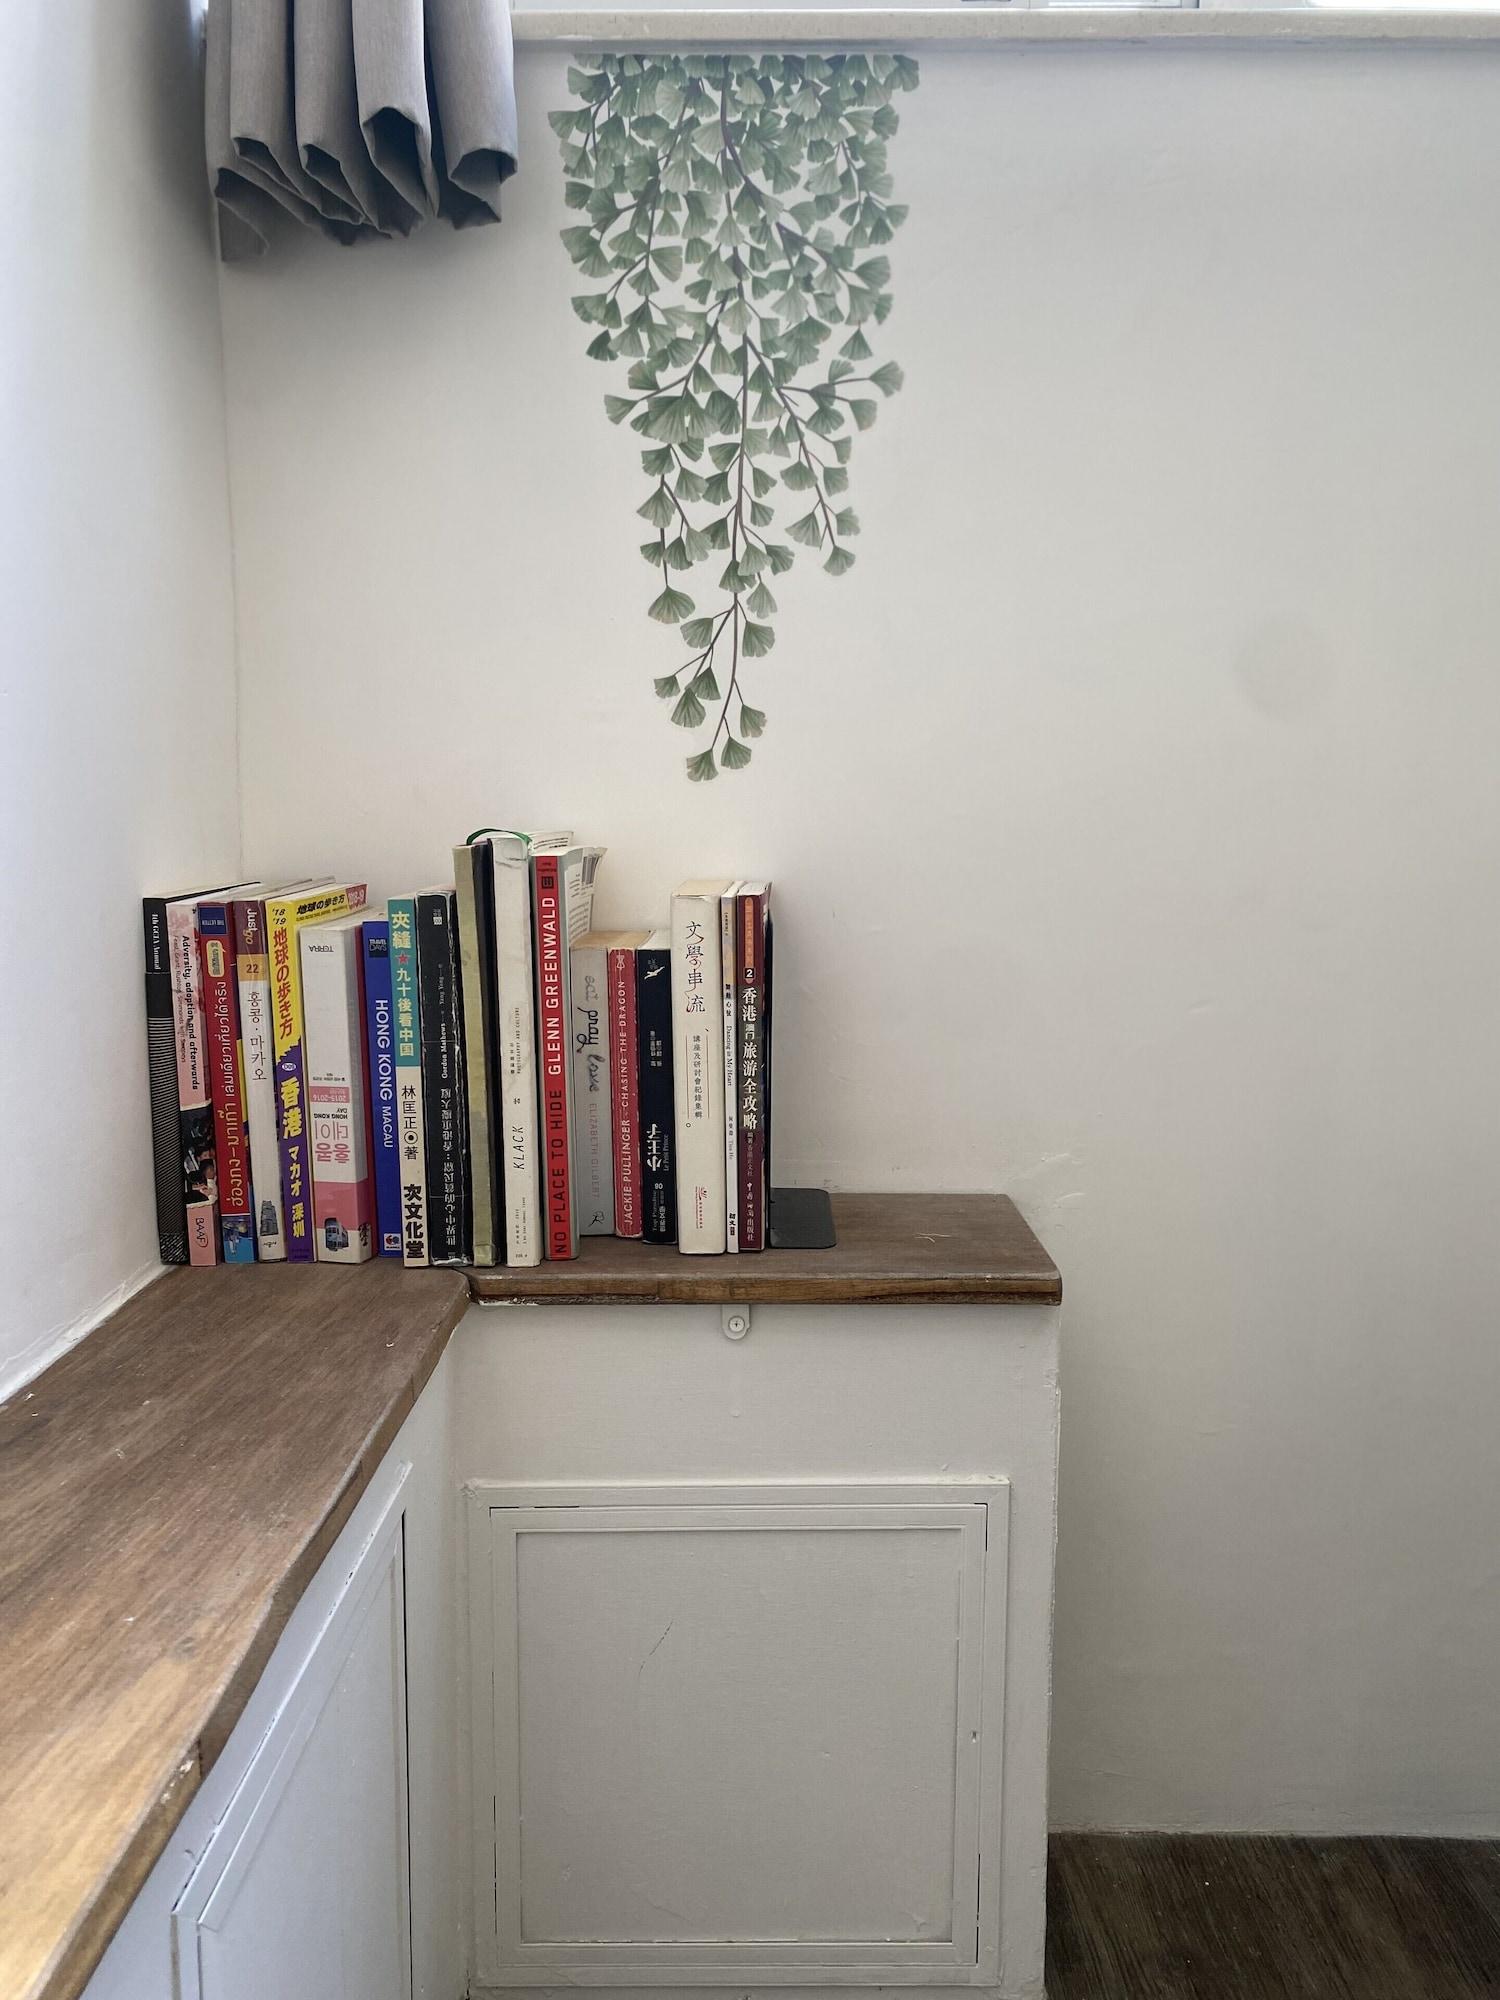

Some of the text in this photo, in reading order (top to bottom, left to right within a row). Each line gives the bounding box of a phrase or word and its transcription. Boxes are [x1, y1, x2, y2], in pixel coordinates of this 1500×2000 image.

[272, 908, 286, 917] '18
[272, 917, 287, 926] '19
[391, 911, 412, 949] 夾縫
[153, 945, 162, 970] Annual
[246, 964, 259, 974] 22
[685, 920, 705, 1013] 文學串流
[746, 968, 753, 978] 2
[273, 928, 294, 1040] 地球の歩き方
[541, 897, 562, 1075] GLENN GREENWALD
[182, 936, 200, 1090] Adversity, adoption and afterwards
[577, 975, 606, 1092] eat pray love
[375, 999, 394, 1148] HONG KONG MACAU
[726, 1058, 733, 1068] My
[280, 1077, 303, 1140] 香港
[313, 1094, 346, 1102] 2015-2016
[313, 1112, 330, 1120] KONG
[618, 981, 633, 1225] JACKIE PULLINGER CHASING THE DRAGON
[314, 1120, 349, 1140] 데이
[401, 1084, 419, 1161] 林匡正 著
[314, 1142, 350, 1164] 홍콩
[512, 1126, 525, 1170] KLACK
[589, 1103, 600, 1200] ELIZABETH GILBERT
[646, 1123, 662, 1172] 小王子
[288, 1146, 303, 1197] マカオ
[549, 1090, 567, 1253] NO PLACE TO HIDE
[195, 1217, 206, 1243] BAAF
[291, 1202, 305, 1238] 深圳
[404, 1183, 425, 1259] 次文化堂
